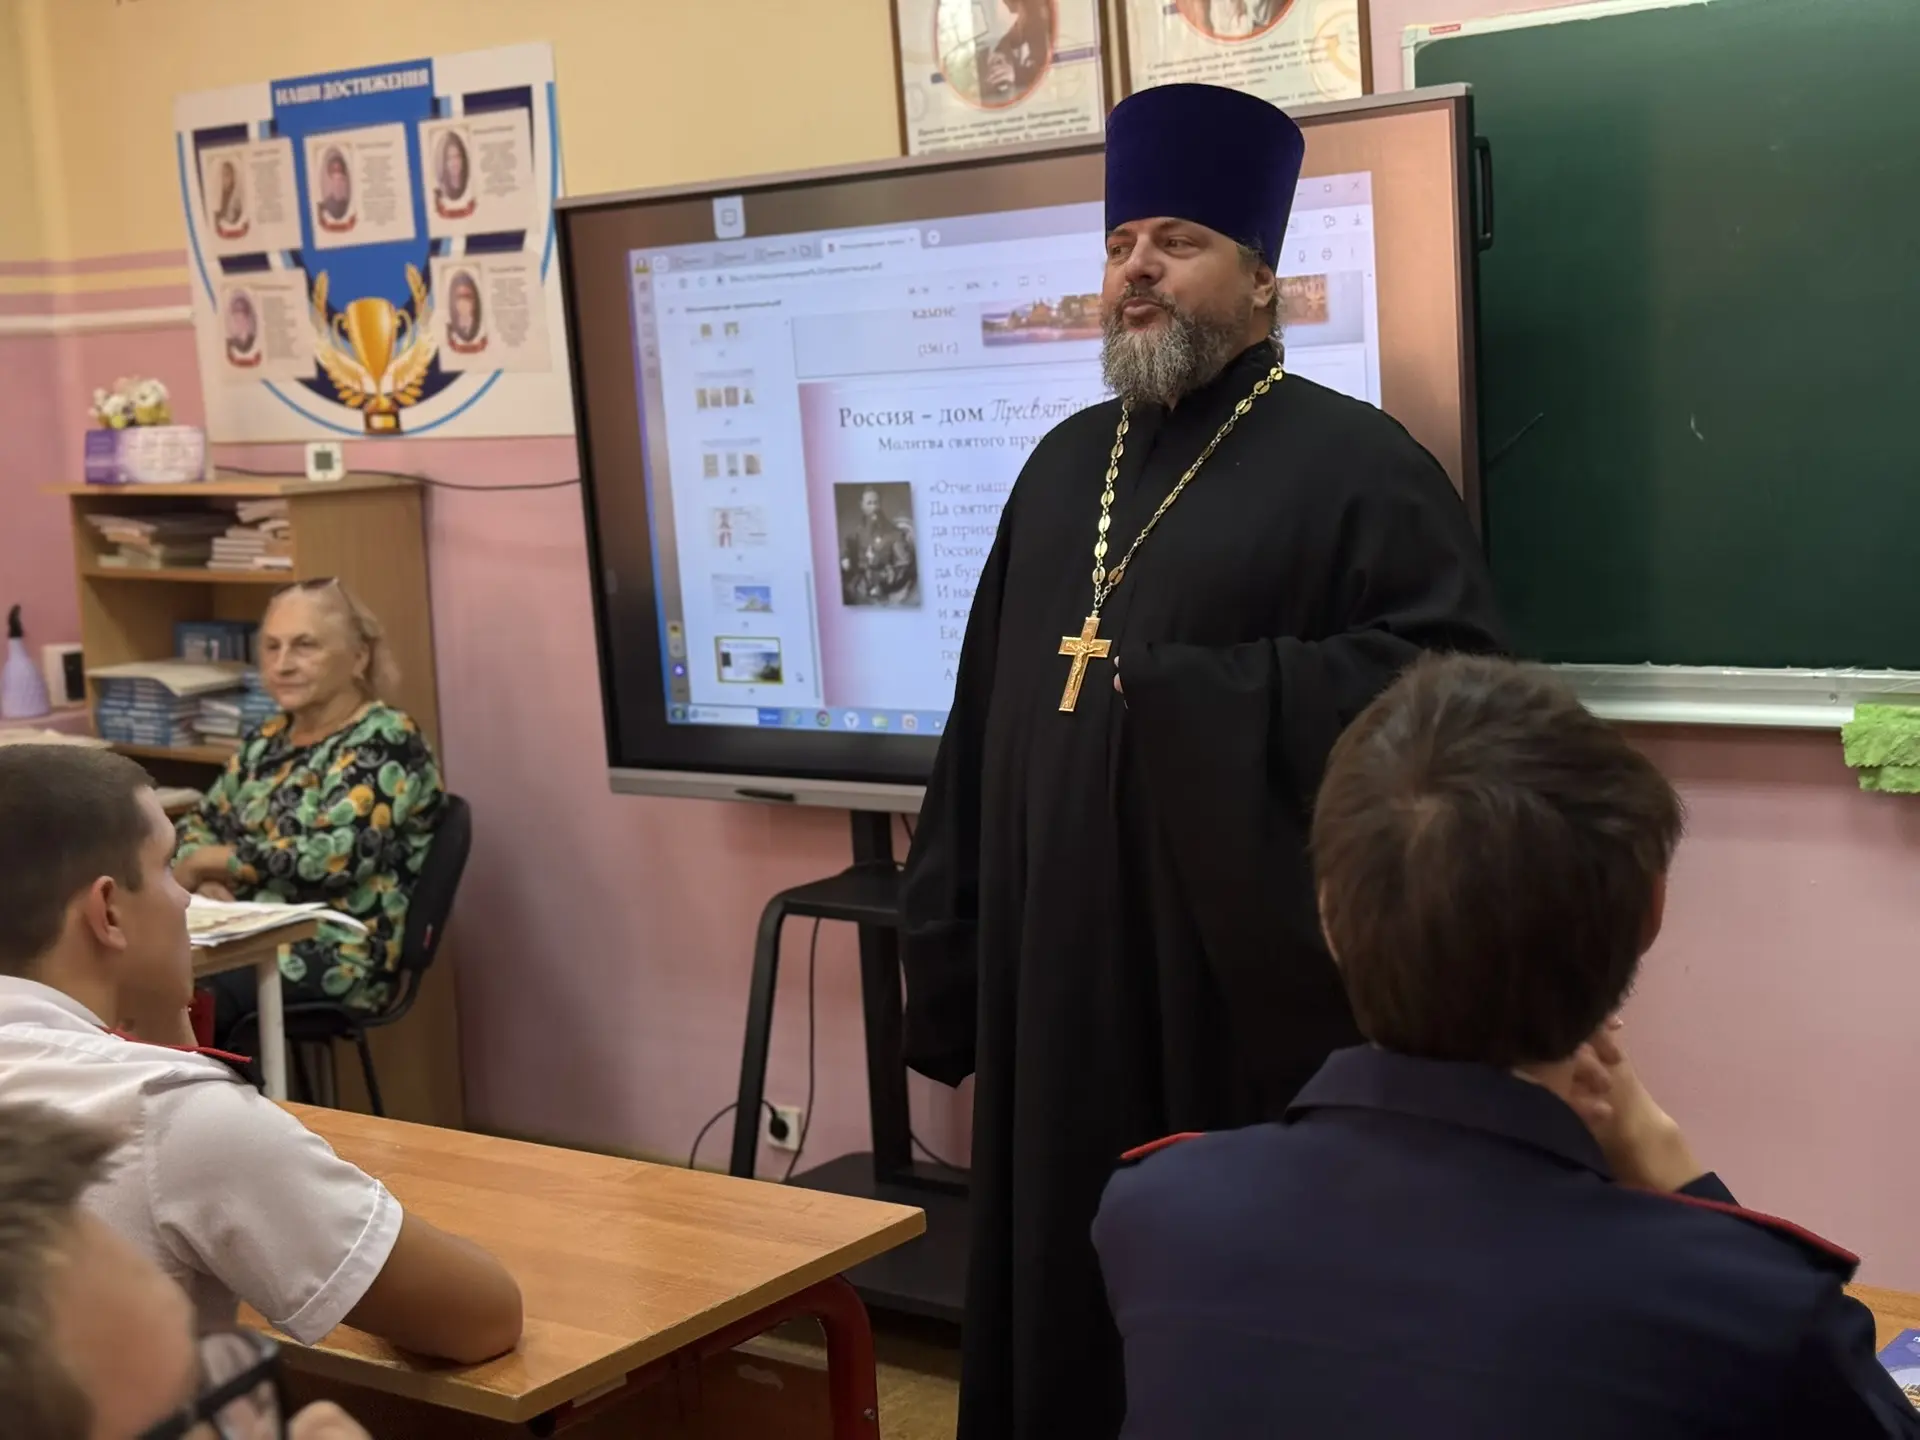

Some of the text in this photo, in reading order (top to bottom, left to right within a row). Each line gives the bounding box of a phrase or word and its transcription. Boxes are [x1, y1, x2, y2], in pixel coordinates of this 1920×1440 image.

[275, 68, 429, 106] НАШИ ДОСТИЖЕНИЯ
[838, 407, 915, 428] Россия
[939, 406, 984, 427] дом
[878, 436, 944, 452] Молитва
[948, 436, 1004, 452] святого
[930, 501, 949, 516] Да
[932, 526, 947, 537] да
[937, 585, 948, 598] И
